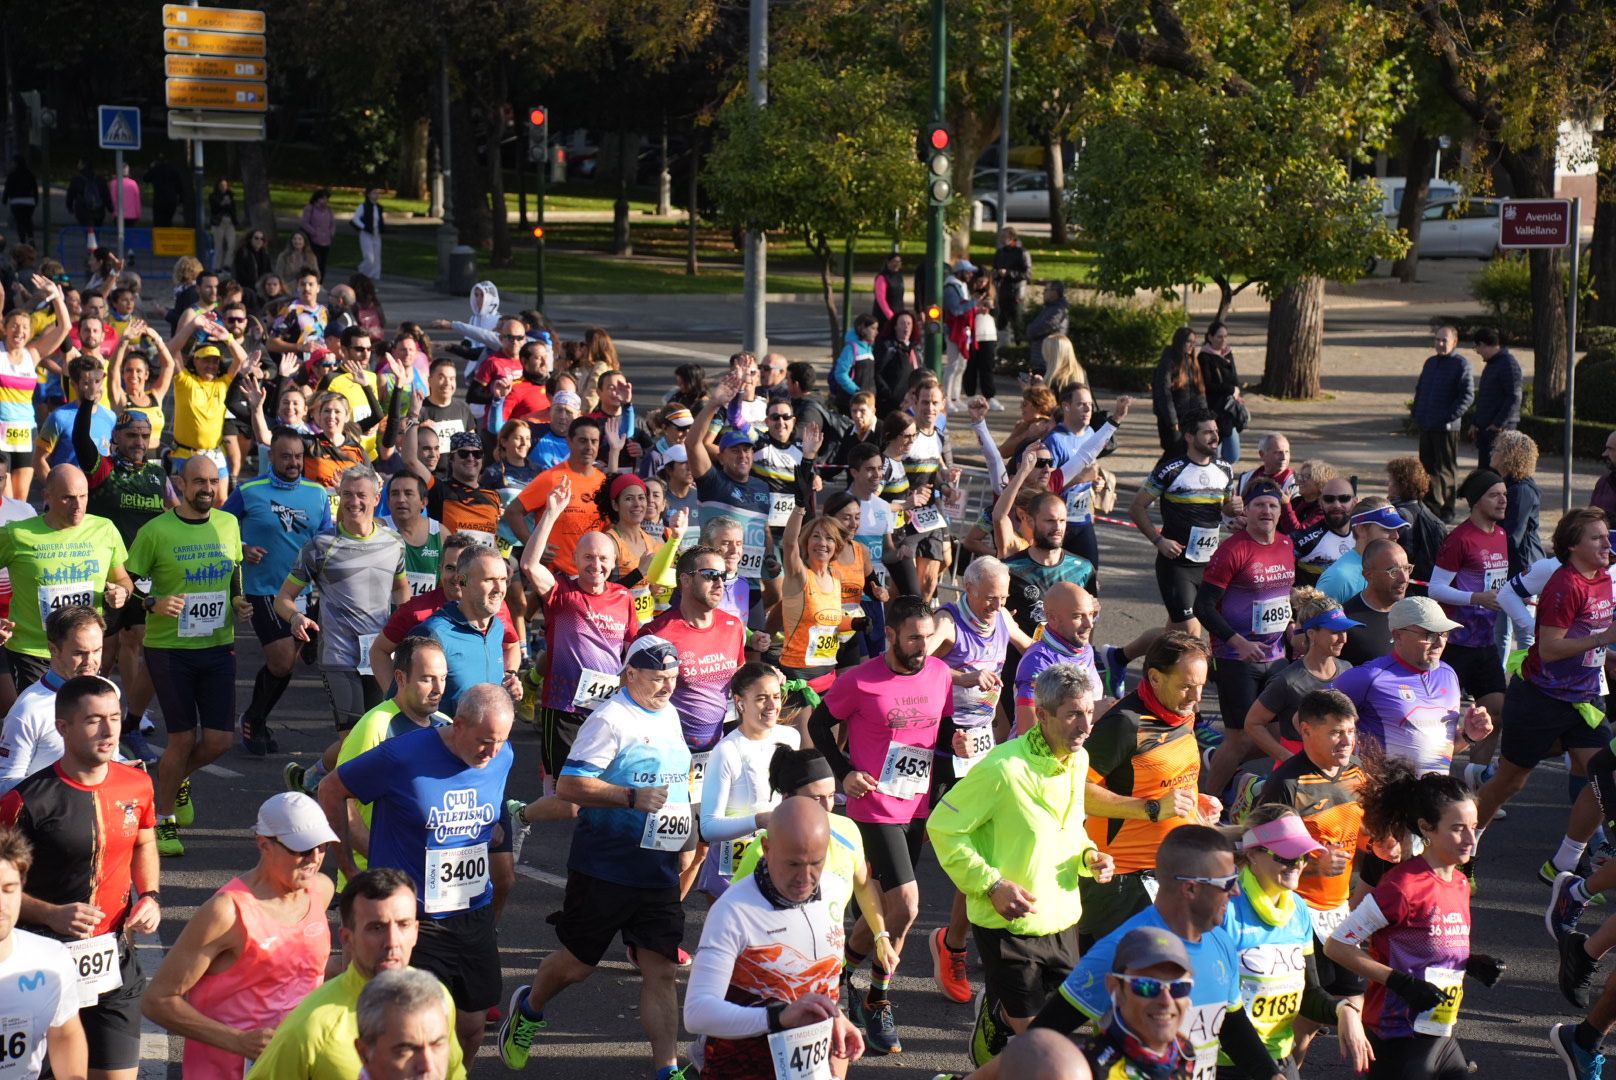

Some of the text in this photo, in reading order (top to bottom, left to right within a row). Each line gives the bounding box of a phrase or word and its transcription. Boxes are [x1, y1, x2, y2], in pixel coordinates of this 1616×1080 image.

[1525, 212, 1562, 222] Avenida
[1515, 226, 1557, 236] Vallellano
[1074, 498, 1088, 509] 41
[173, 544, 203, 553] CARRERA
[738, 554, 761, 568] 918
[1265, 564, 1286, 574] MEDIA
[1253, 575, 1265, 583] 36
[408, 582, 433, 595] 144
[50, 592, 91, 609] 4088
[189, 601, 225, 618] 4087
[1262, 605, 1290, 622] 4895
[698, 653, 727, 665] MEDIA
[683, 666, 697, 677] 36
[894, 698, 900, 706] X
[633, 772, 657, 783] LOS
[446, 790, 475, 810] CLUB
[427, 806, 493, 828] ATLETISMO
[437, 822, 480, 840] ORIPPO
[657, 815, 690, 835] 2960
[733, 841, 752, 860] 2
[441, 857, 486, 883] 3400
[1429, 924, 1442, 936] 36
[73, 949, 114, 977] 697
[1252, 992, 1298, 1018] 3183
[790, 1037, 828, 1072] 4783
